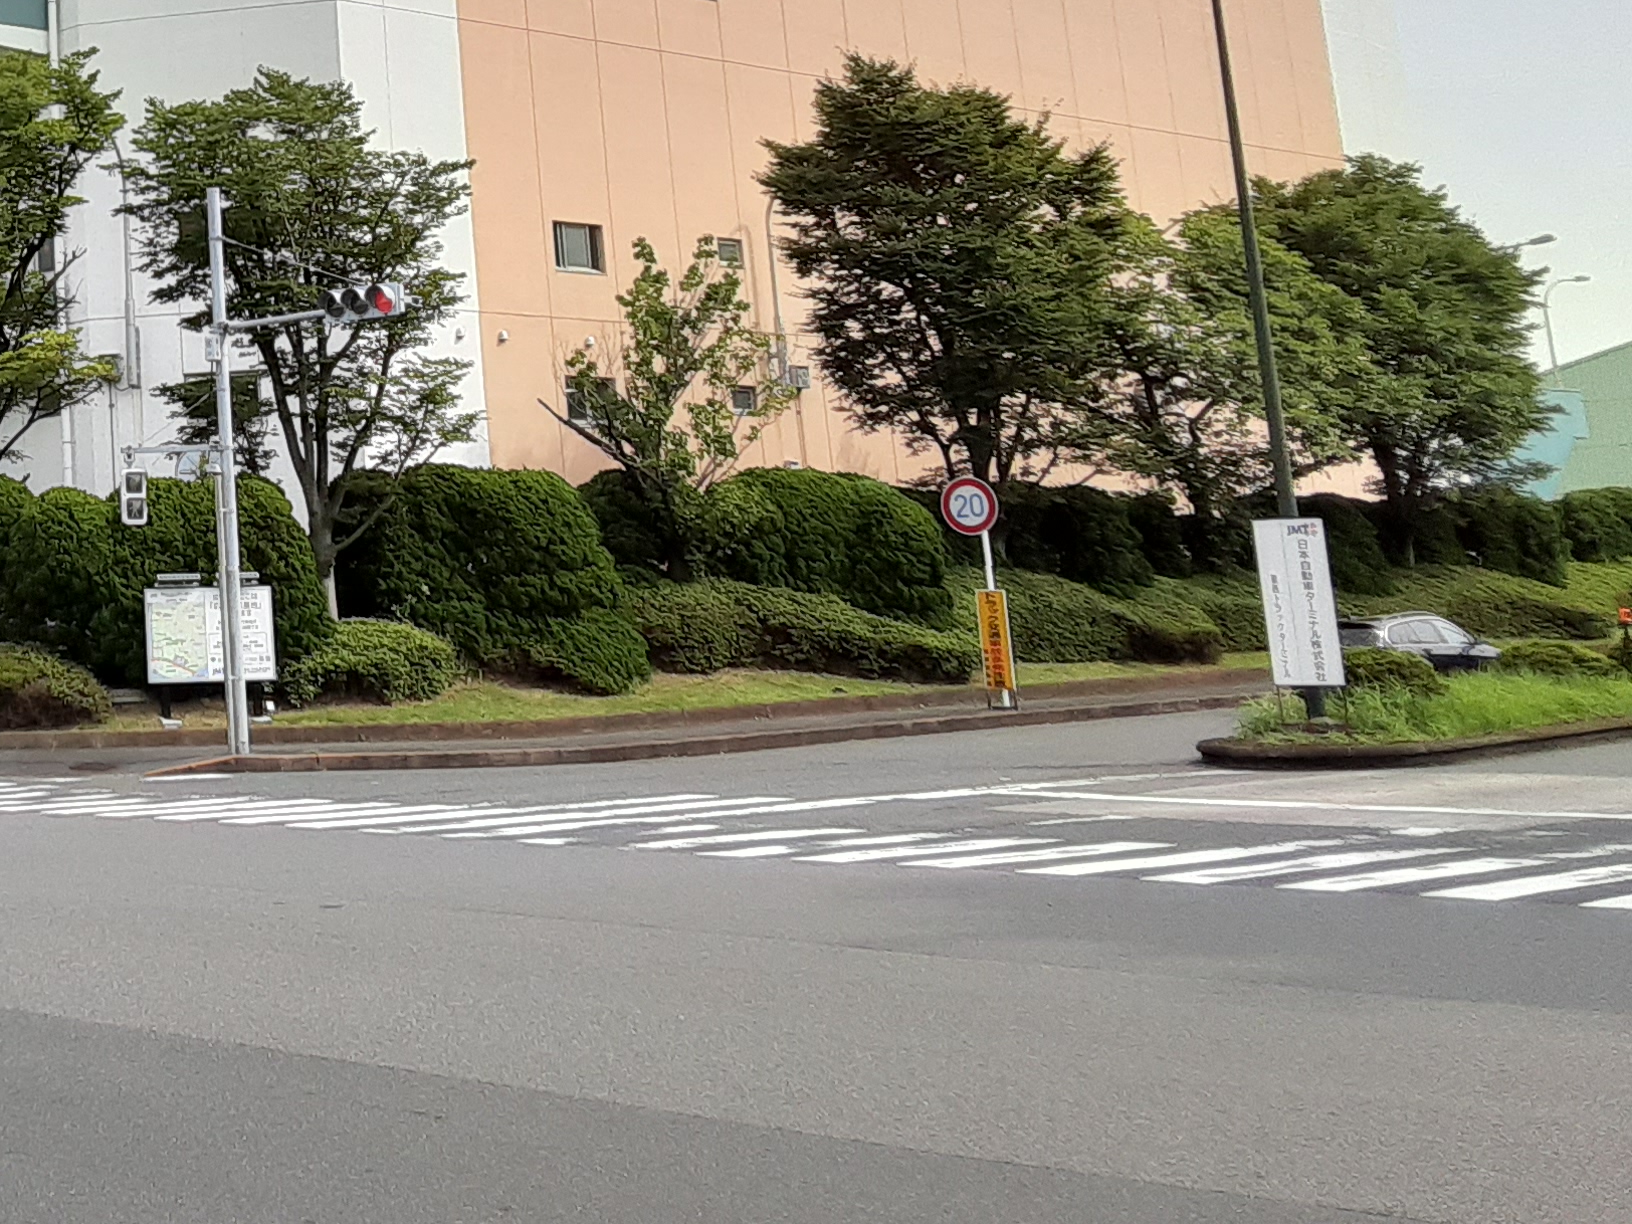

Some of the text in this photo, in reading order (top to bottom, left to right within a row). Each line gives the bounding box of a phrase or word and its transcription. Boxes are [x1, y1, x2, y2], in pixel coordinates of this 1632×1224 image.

[953, 493, 985, 519] 20
[1286, 524, 1310, 537] JMT
[1297, 539, 1327, 682] 日本自動車ターミナル株式会社
